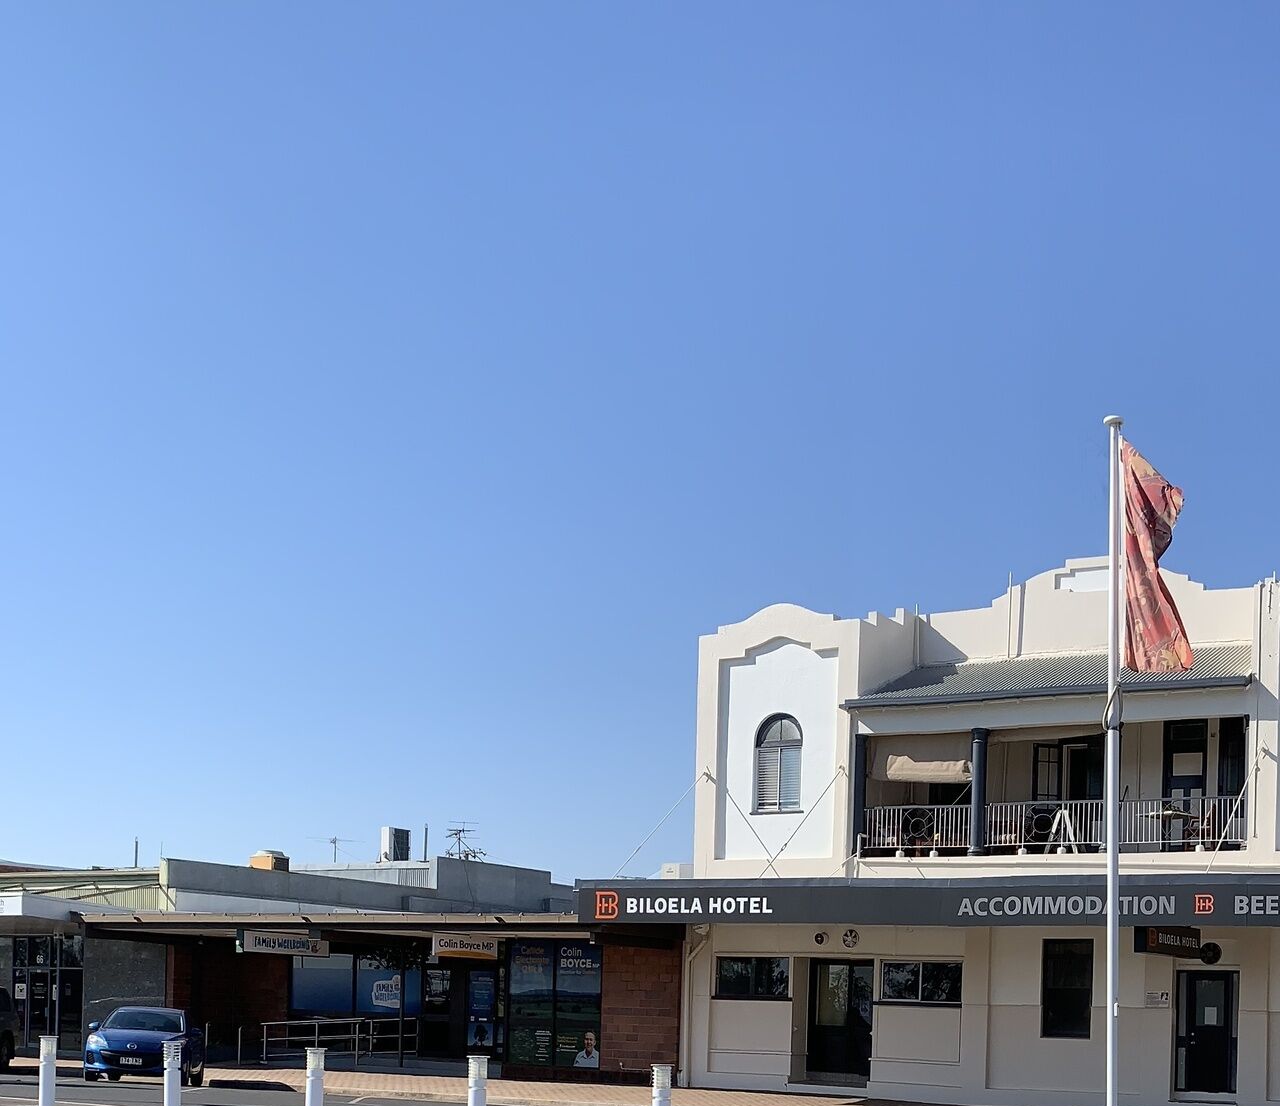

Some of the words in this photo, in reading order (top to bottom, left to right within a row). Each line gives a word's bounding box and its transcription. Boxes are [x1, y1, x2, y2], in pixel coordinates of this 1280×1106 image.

[626, 897, 703, 914] BILOELA
[708, 897, 773, 914] HOTEL
[438, 938, 458, 949] Colin
[459, 940, 481, 951] Boyce
[482, 941, 494, 951] MP
[1158, 932, 1180, 946] BILOELA
[1181, 936, 1199, 949] HOTEL
[560, 946, 582, 957] Colin
[560, 958, 592, 968] BOYCE
